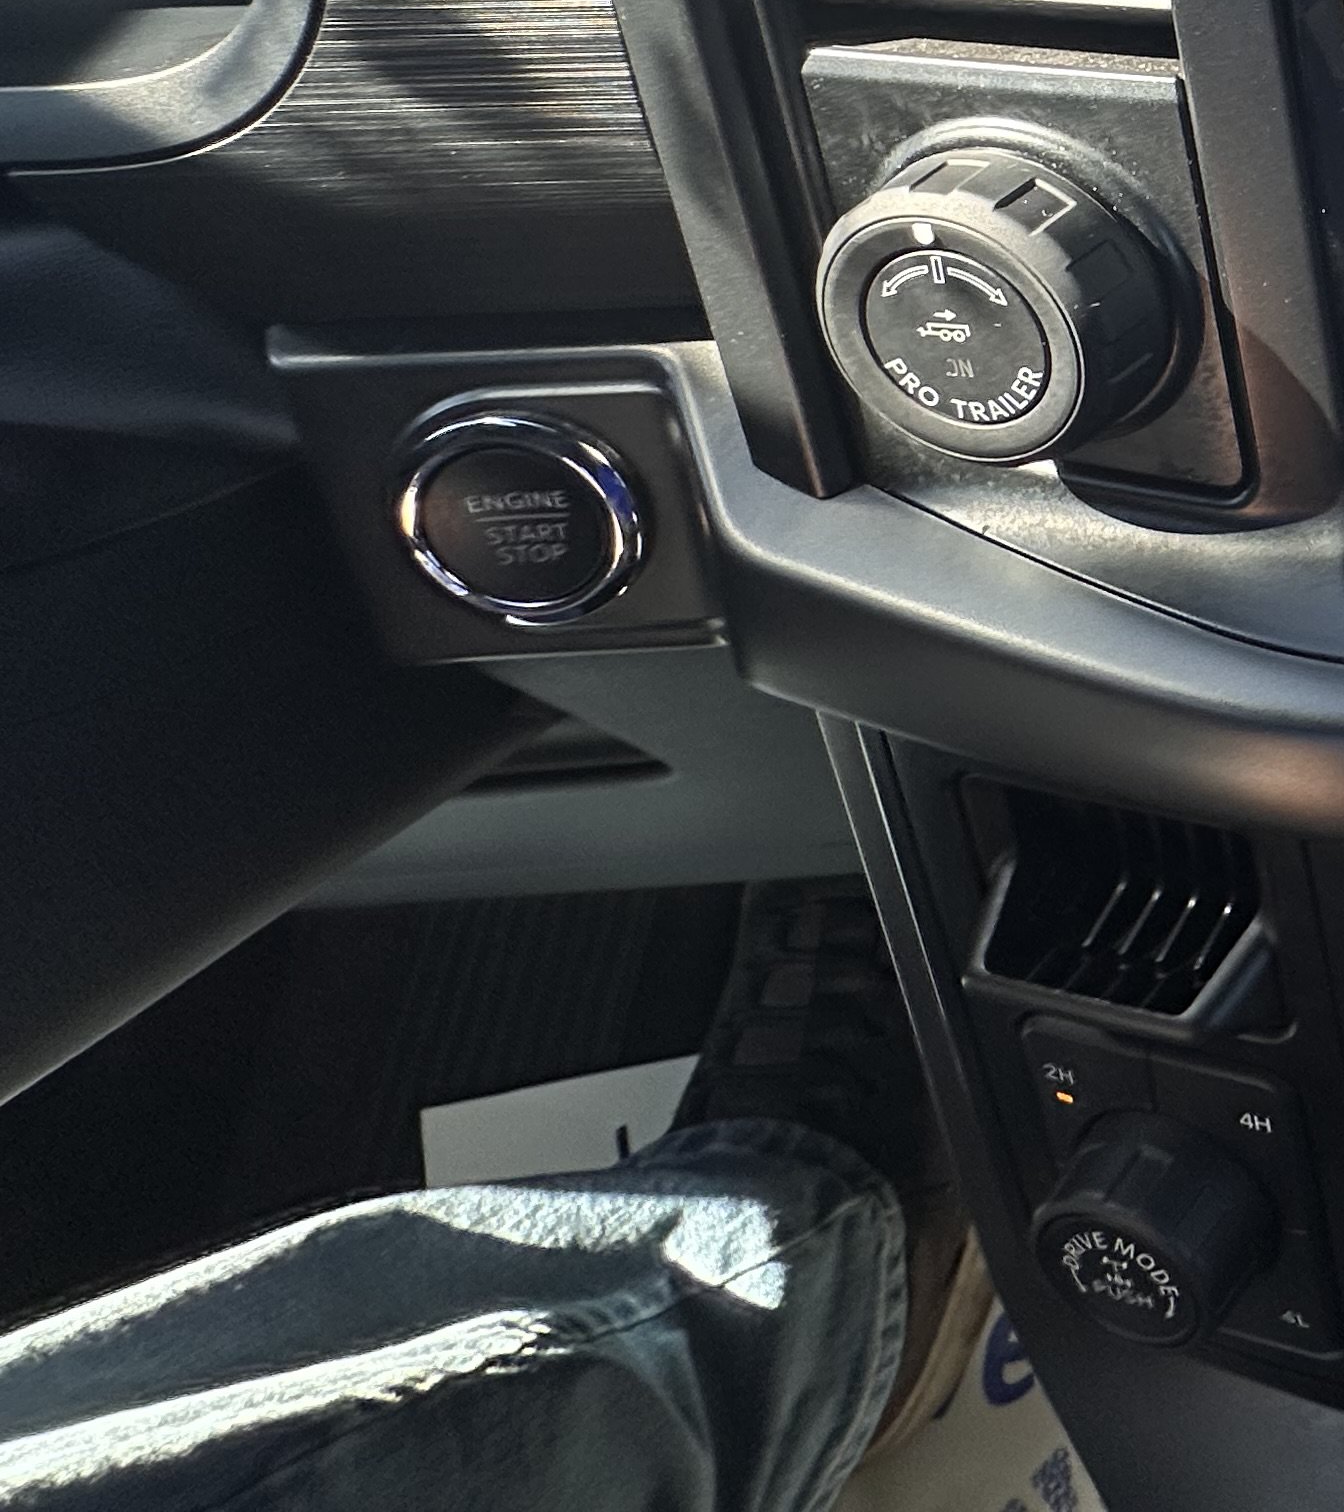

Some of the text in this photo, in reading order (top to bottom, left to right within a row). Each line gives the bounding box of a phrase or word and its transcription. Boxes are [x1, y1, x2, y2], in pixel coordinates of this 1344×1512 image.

[884, 356, 1044, 422] PRO TRAILER
[465, 490, 569, 514] ENGINE
[485, 522, 569, 545] START
[497, 544, 569, 566] STOP
[1043, 1063, 1075, 1085] 2H
[1239, 1112, 1272, 1134] 4H
[1062, 1232, 1180, 1299] DRIVE MODE
